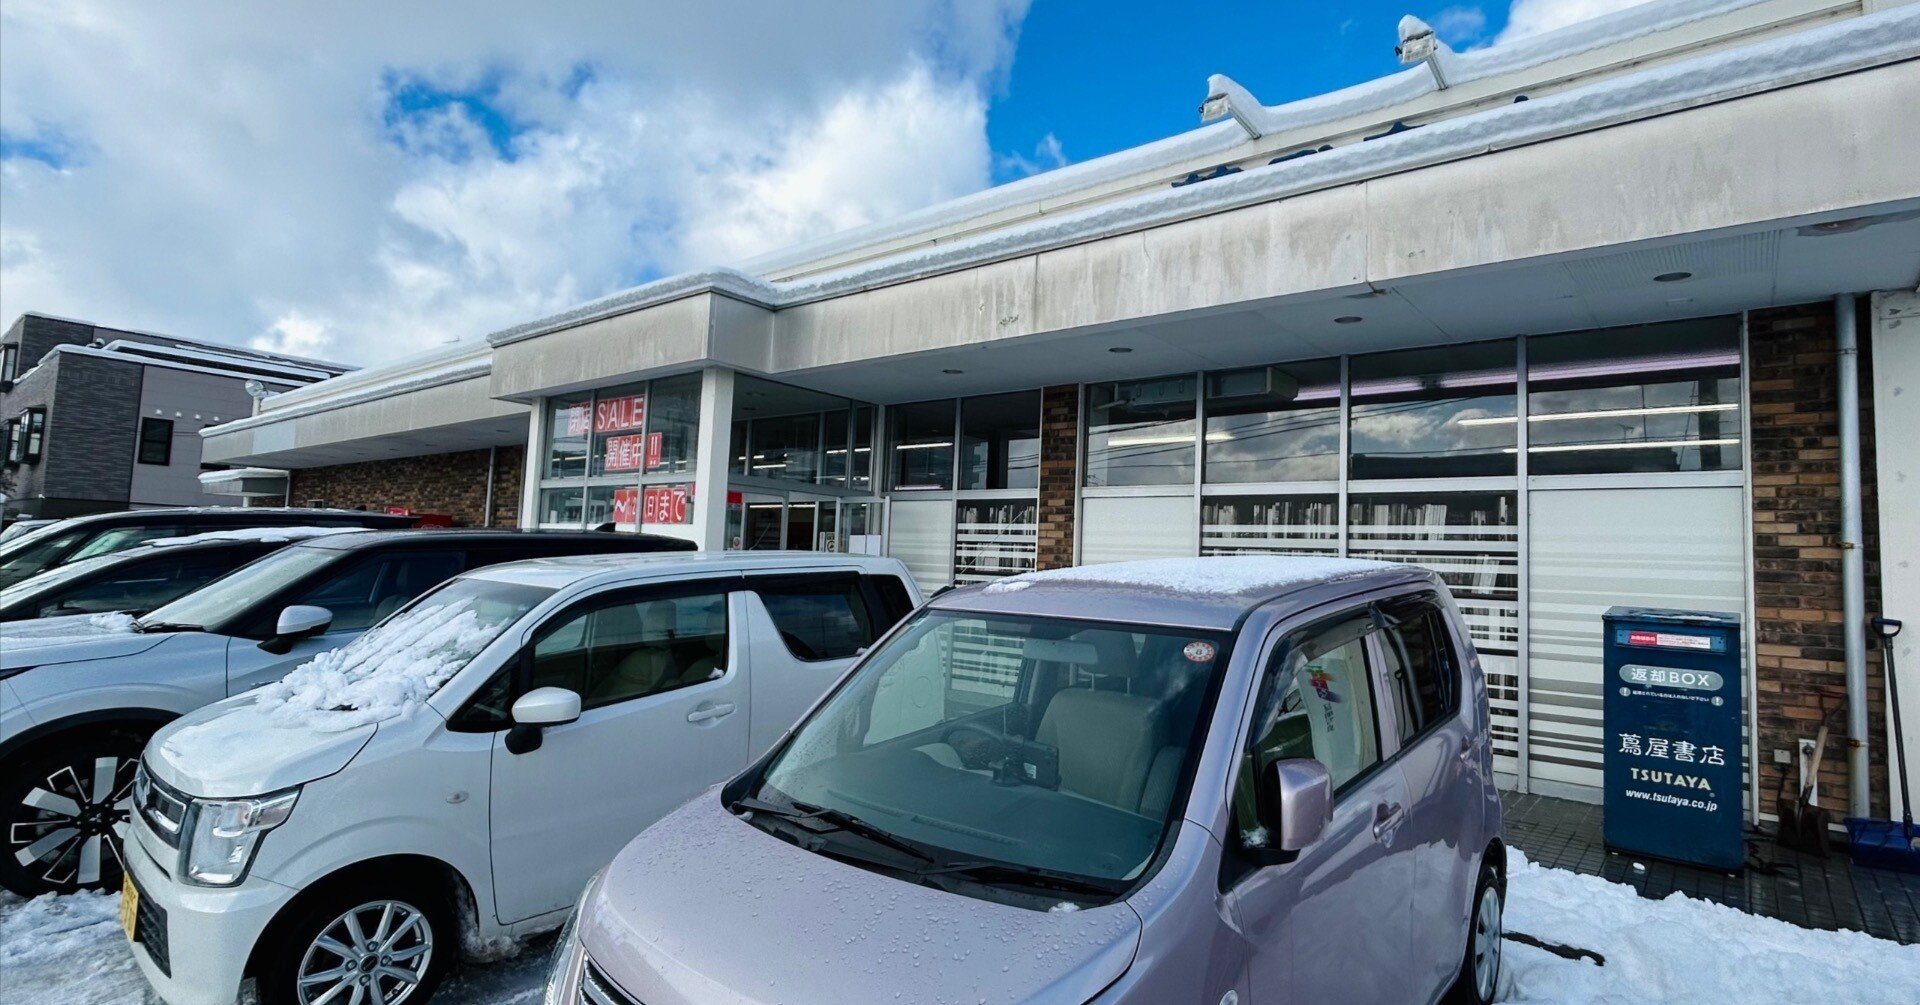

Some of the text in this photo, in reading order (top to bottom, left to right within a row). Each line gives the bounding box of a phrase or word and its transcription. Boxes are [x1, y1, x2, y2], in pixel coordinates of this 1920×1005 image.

[1631, 668, 1710, 687] 返却BOX
[1619, 733, 1725, 766] 蔦屋書店
[1630, 767, 1712, 791] TSUTAYA
[1625, 789, 1718, 812] www.tsutaya.co.jp
